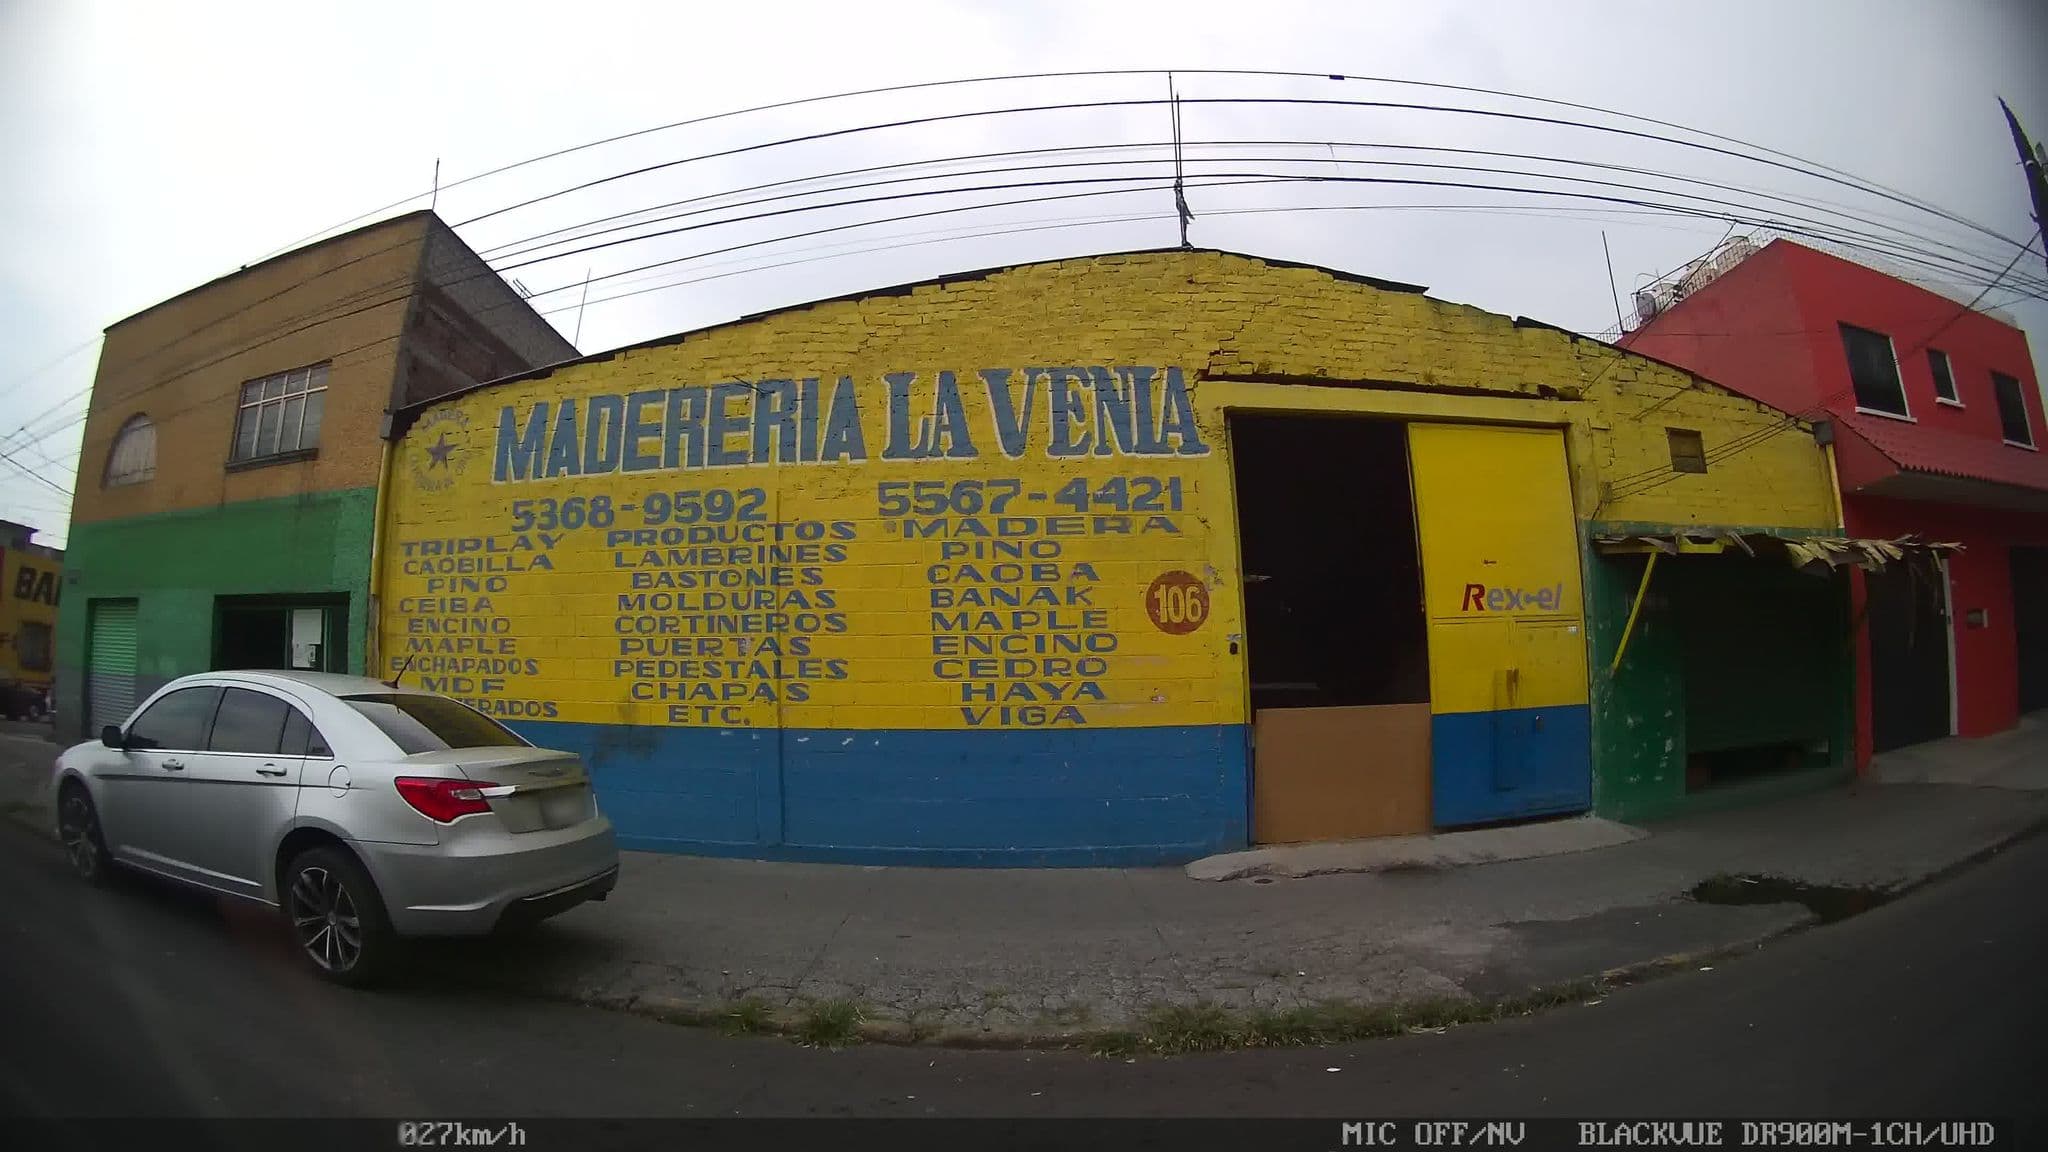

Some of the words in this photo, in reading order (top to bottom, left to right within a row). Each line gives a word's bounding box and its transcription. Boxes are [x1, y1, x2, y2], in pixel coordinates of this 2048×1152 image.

[492, 377, 866, 484] MADERERIA
[881, 370, 978, 461] LA
[977, 366, 1211, 459] VENIA
[878, 476, 1183, 516] 5567-4421
[511, 487, 768, 532] 5368-9592
[606, 521, 857, 547] PRODUCTOS
[903, 516, 1182, 538] MADERA
[400, 533, 565, 557] TRIPLAY
[614, 544, 848, 567] LAMBRINES
[941, 540, 1061, 560] PINO
[404, 553, 555, 575] CAOBILLA
[927, 563, 1100, 584] CAOBA
[428, 576, 508, 593] PINO
[632, 567, 824, 589] BASTONES
[400, 597, 494, 614] CEIBA
[617, 590, 838, 612] MOLDURAS
[930, 586, 1093, 608] BANAK
[1154, 584, 1202, 623] 106
[408, 617, 511, 634] ENCINO
[614, 612, 848, 634] CORTINEROS
[931, 610, 1109, 631] MAPLE
[406, 637, 517, 655] MAPLE
[619, 636, 811, 657] PUERTAS
[932, 634, 1119, 655] ENCINO
[390, 656, 540, 676] ENCHAPADOS
[614, 659, 849, 680] PEDESTALES
[933, 657, 1108, 679] CEDRO
[421, 677, 506, 694] MDF
[631, 682, 810, 702] CHAPAS
[961, 682, 1106, 702] HAYA
[668, 704, 750, 726] ETC.
[960, 706, 1087, 726] VIGA
